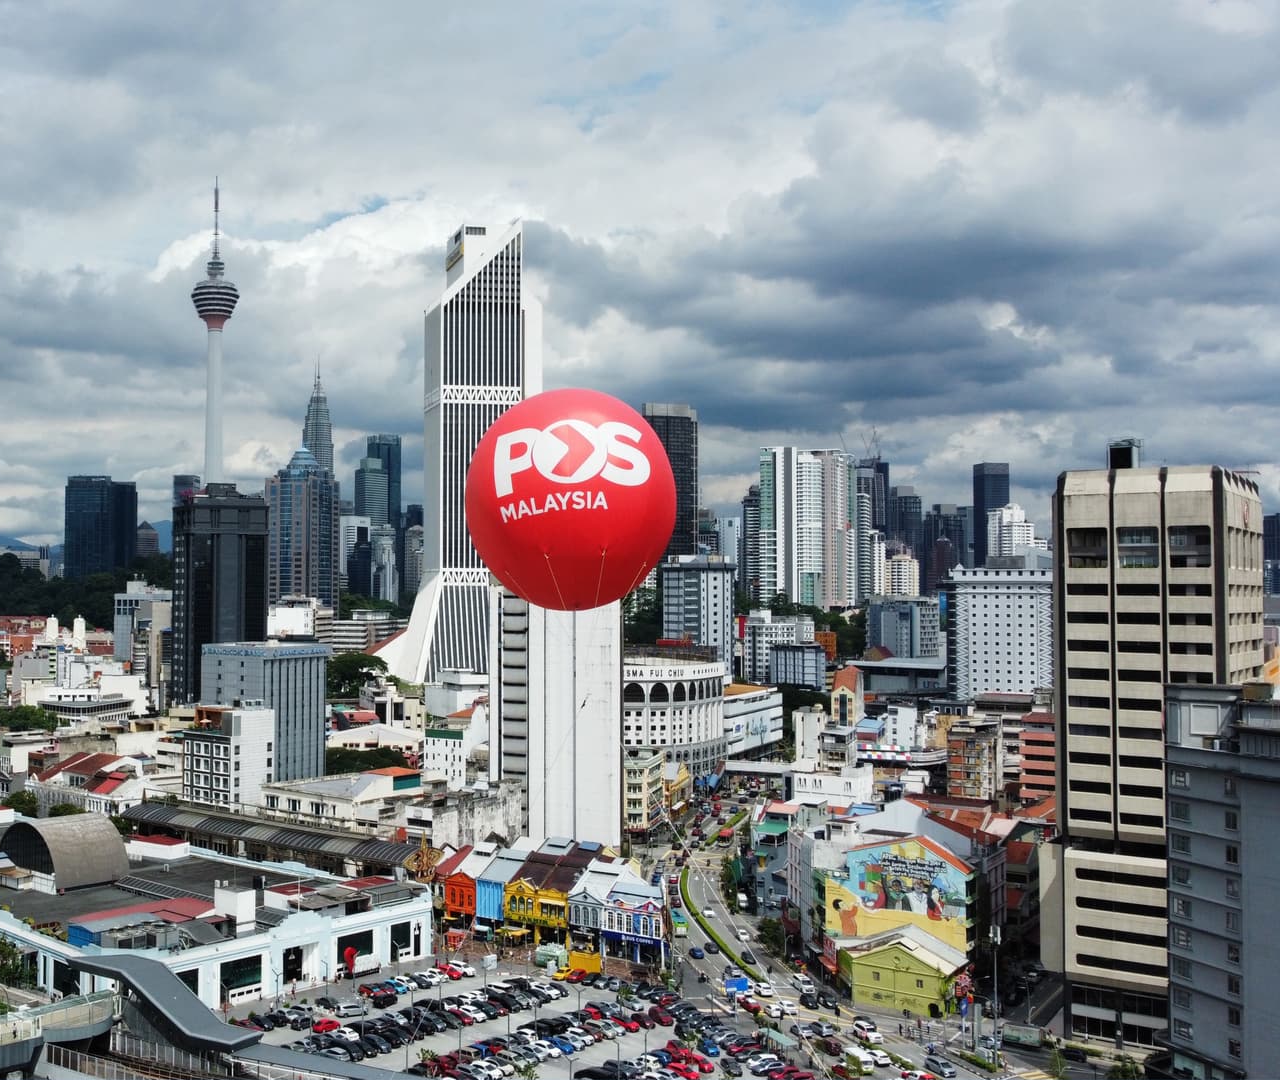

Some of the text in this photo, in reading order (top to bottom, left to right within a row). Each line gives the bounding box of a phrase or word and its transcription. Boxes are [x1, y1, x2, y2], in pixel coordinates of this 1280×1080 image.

[493, 418, 651, 499] POS
[499, 491, 609, 523] MALAYSIA
[650, 669, 663, 678] FUI
[668, 668, 685, 678] CHIU
